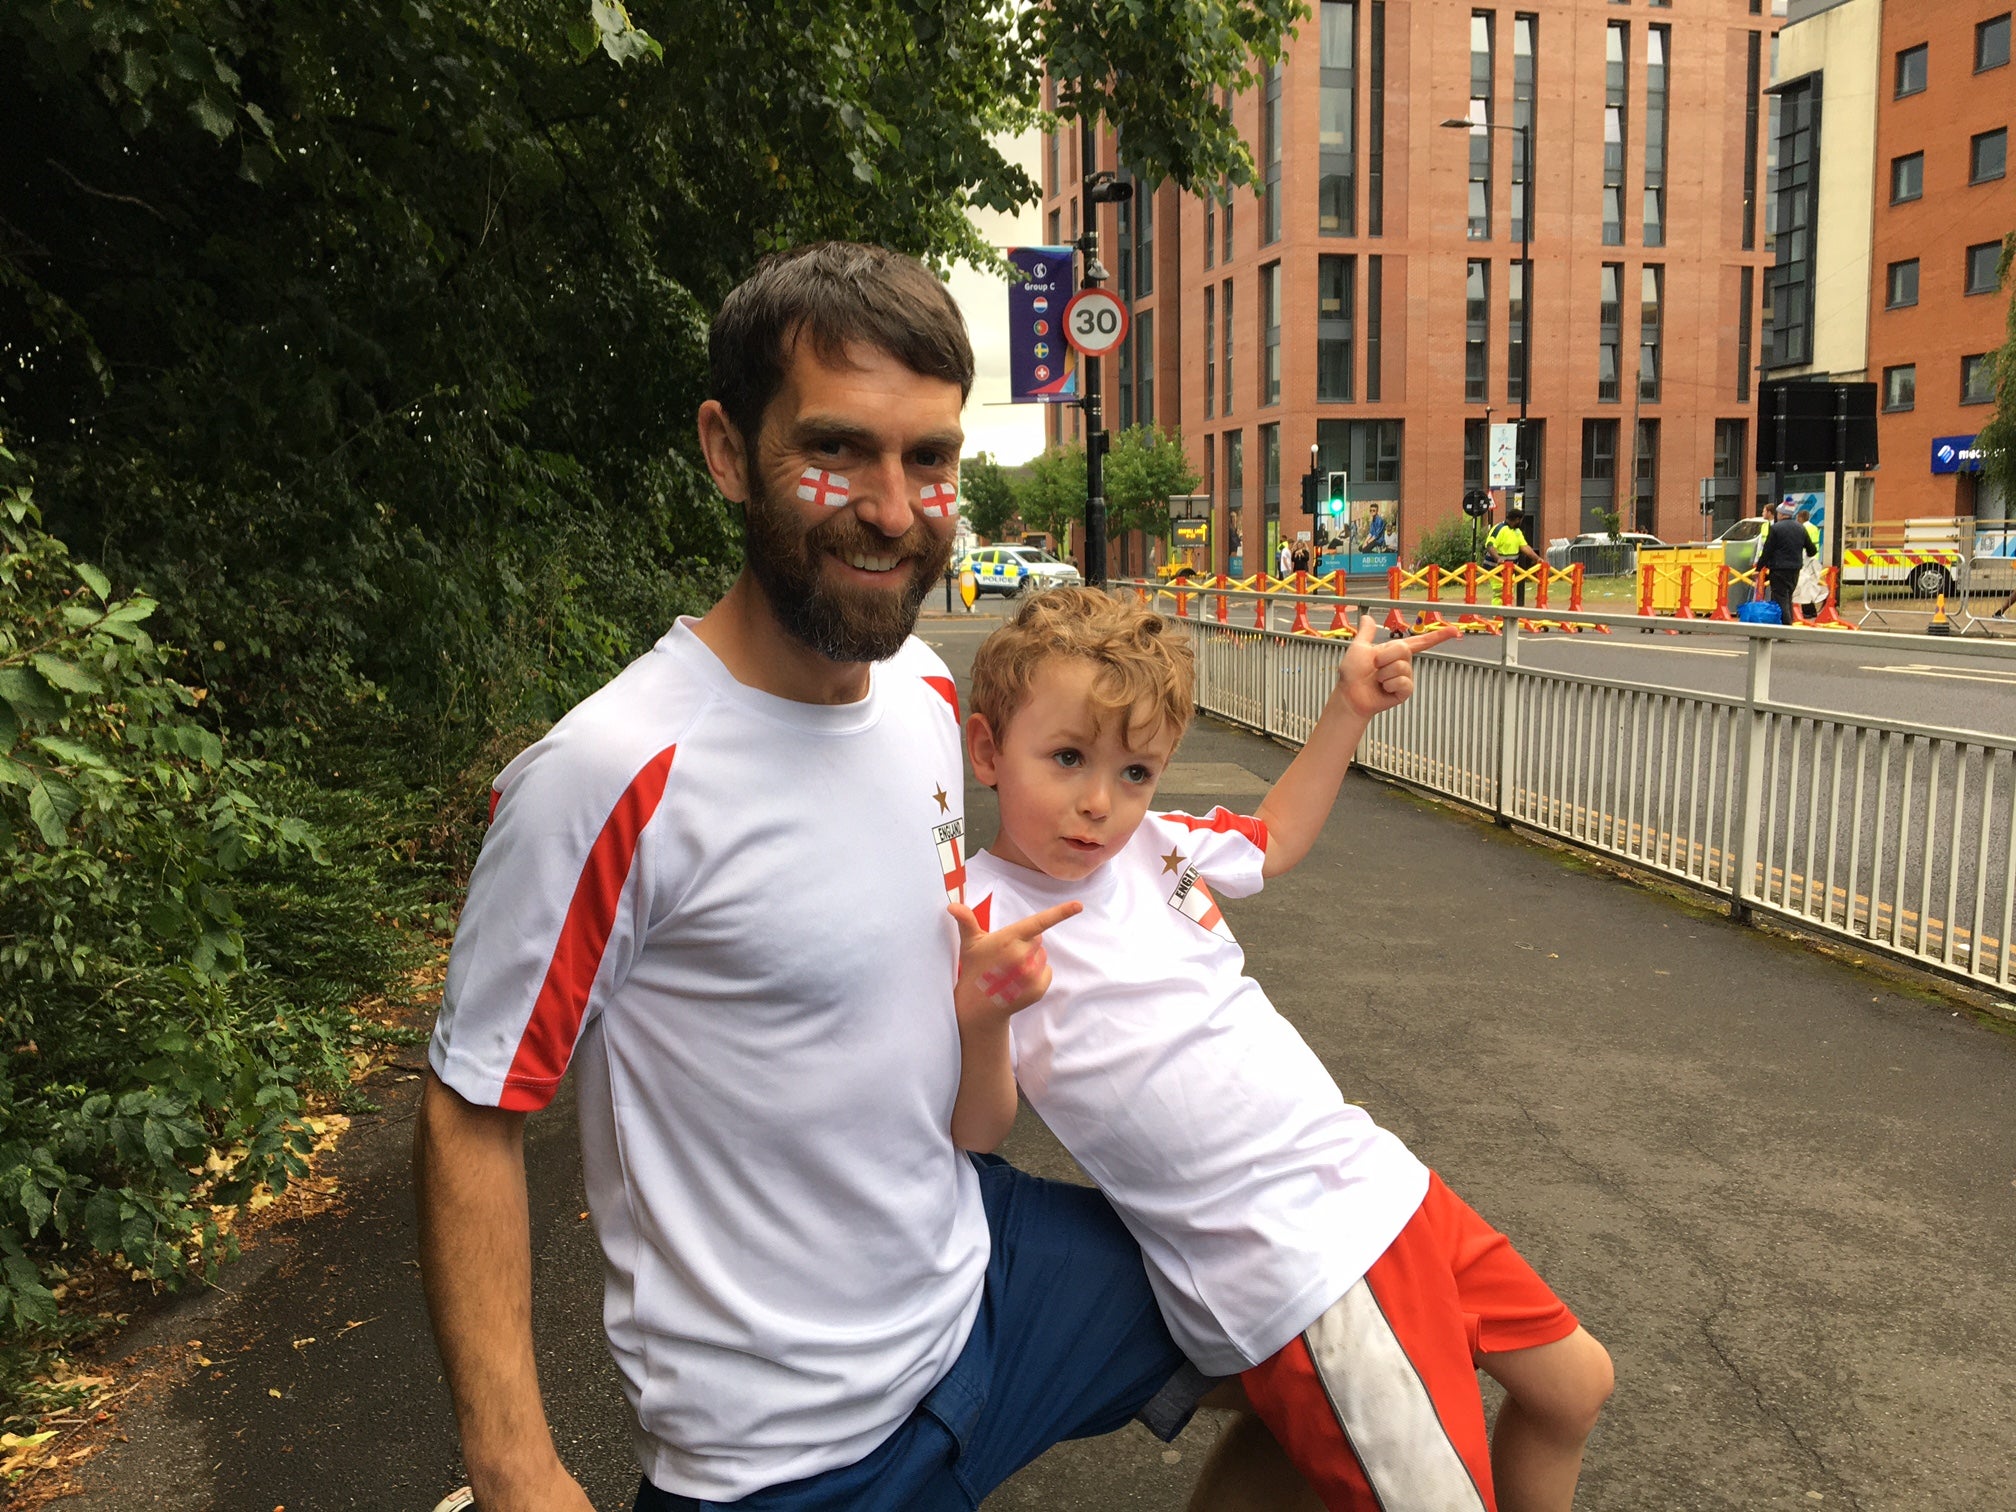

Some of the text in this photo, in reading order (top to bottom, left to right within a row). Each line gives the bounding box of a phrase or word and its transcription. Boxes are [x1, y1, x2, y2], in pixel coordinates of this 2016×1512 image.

[1024, 282, 1056, 292] Group C
[1075, 308, 1118, 335] 30
[982, 576, 1014, 584] POLICE
[938, 821, 962, 842] ENGLAND
